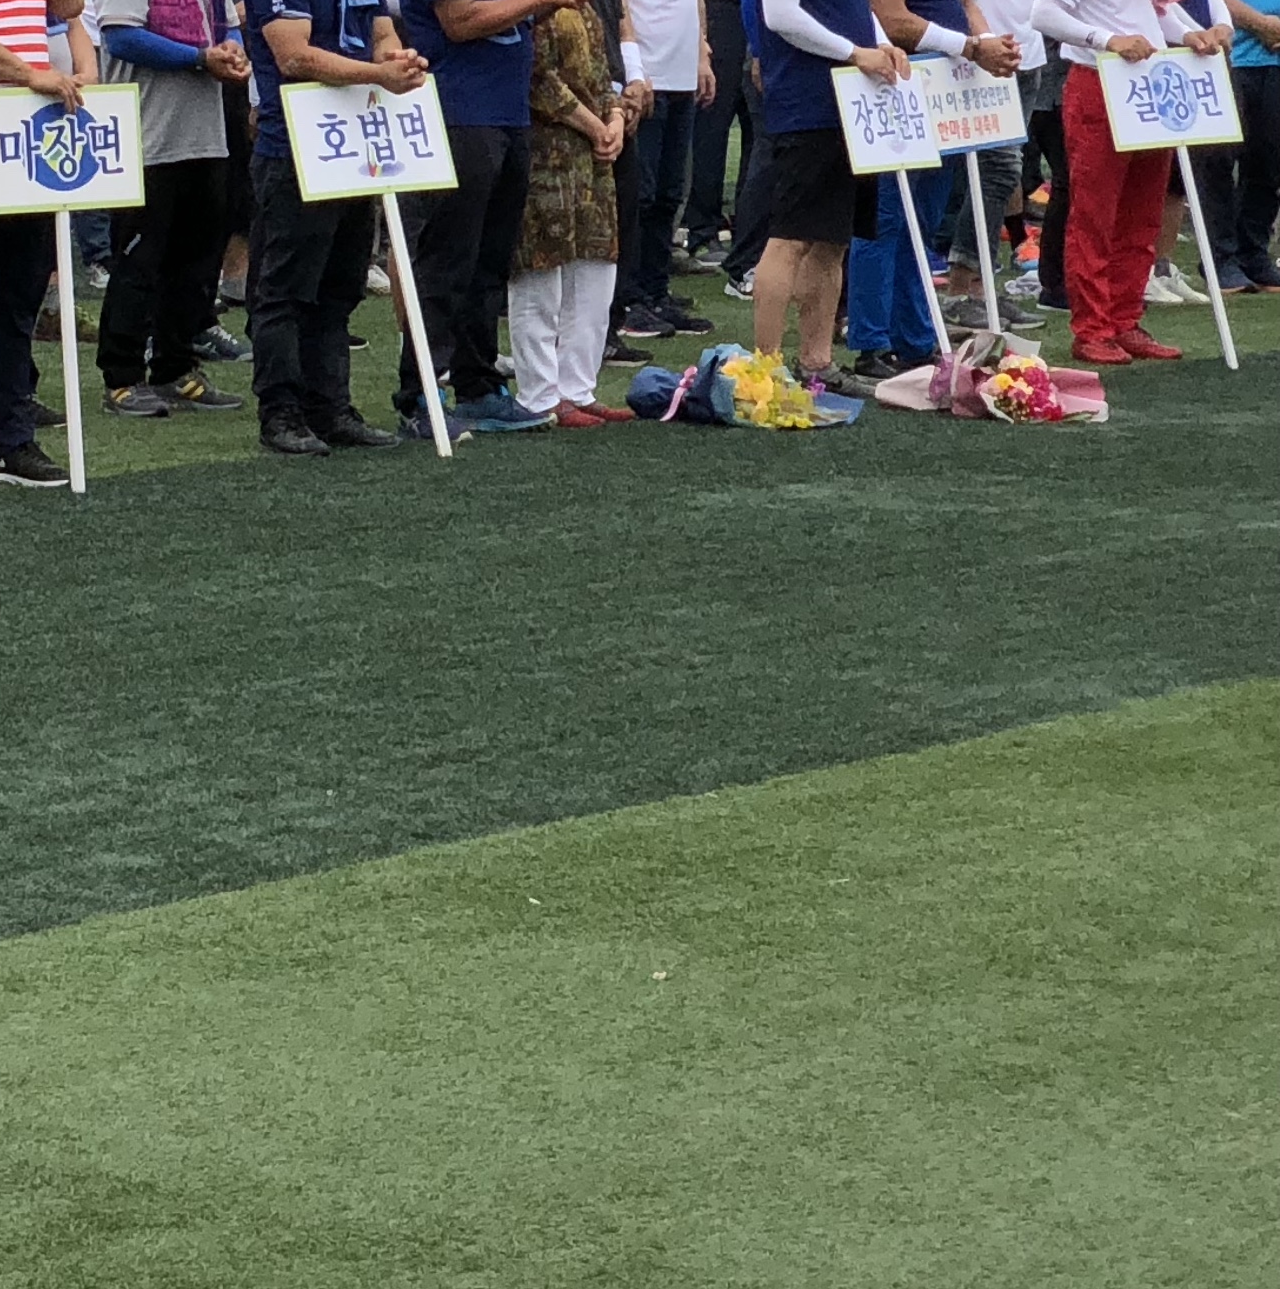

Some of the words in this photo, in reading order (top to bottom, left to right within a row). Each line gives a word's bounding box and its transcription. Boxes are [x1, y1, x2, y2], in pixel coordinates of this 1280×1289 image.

[851, 90, 927, 146] 장호원읍
[1125, 70, 1223, 123] 설성면
[316, 103, 434, 163] 호법면
[937, 117, 972, 142] 한마음
